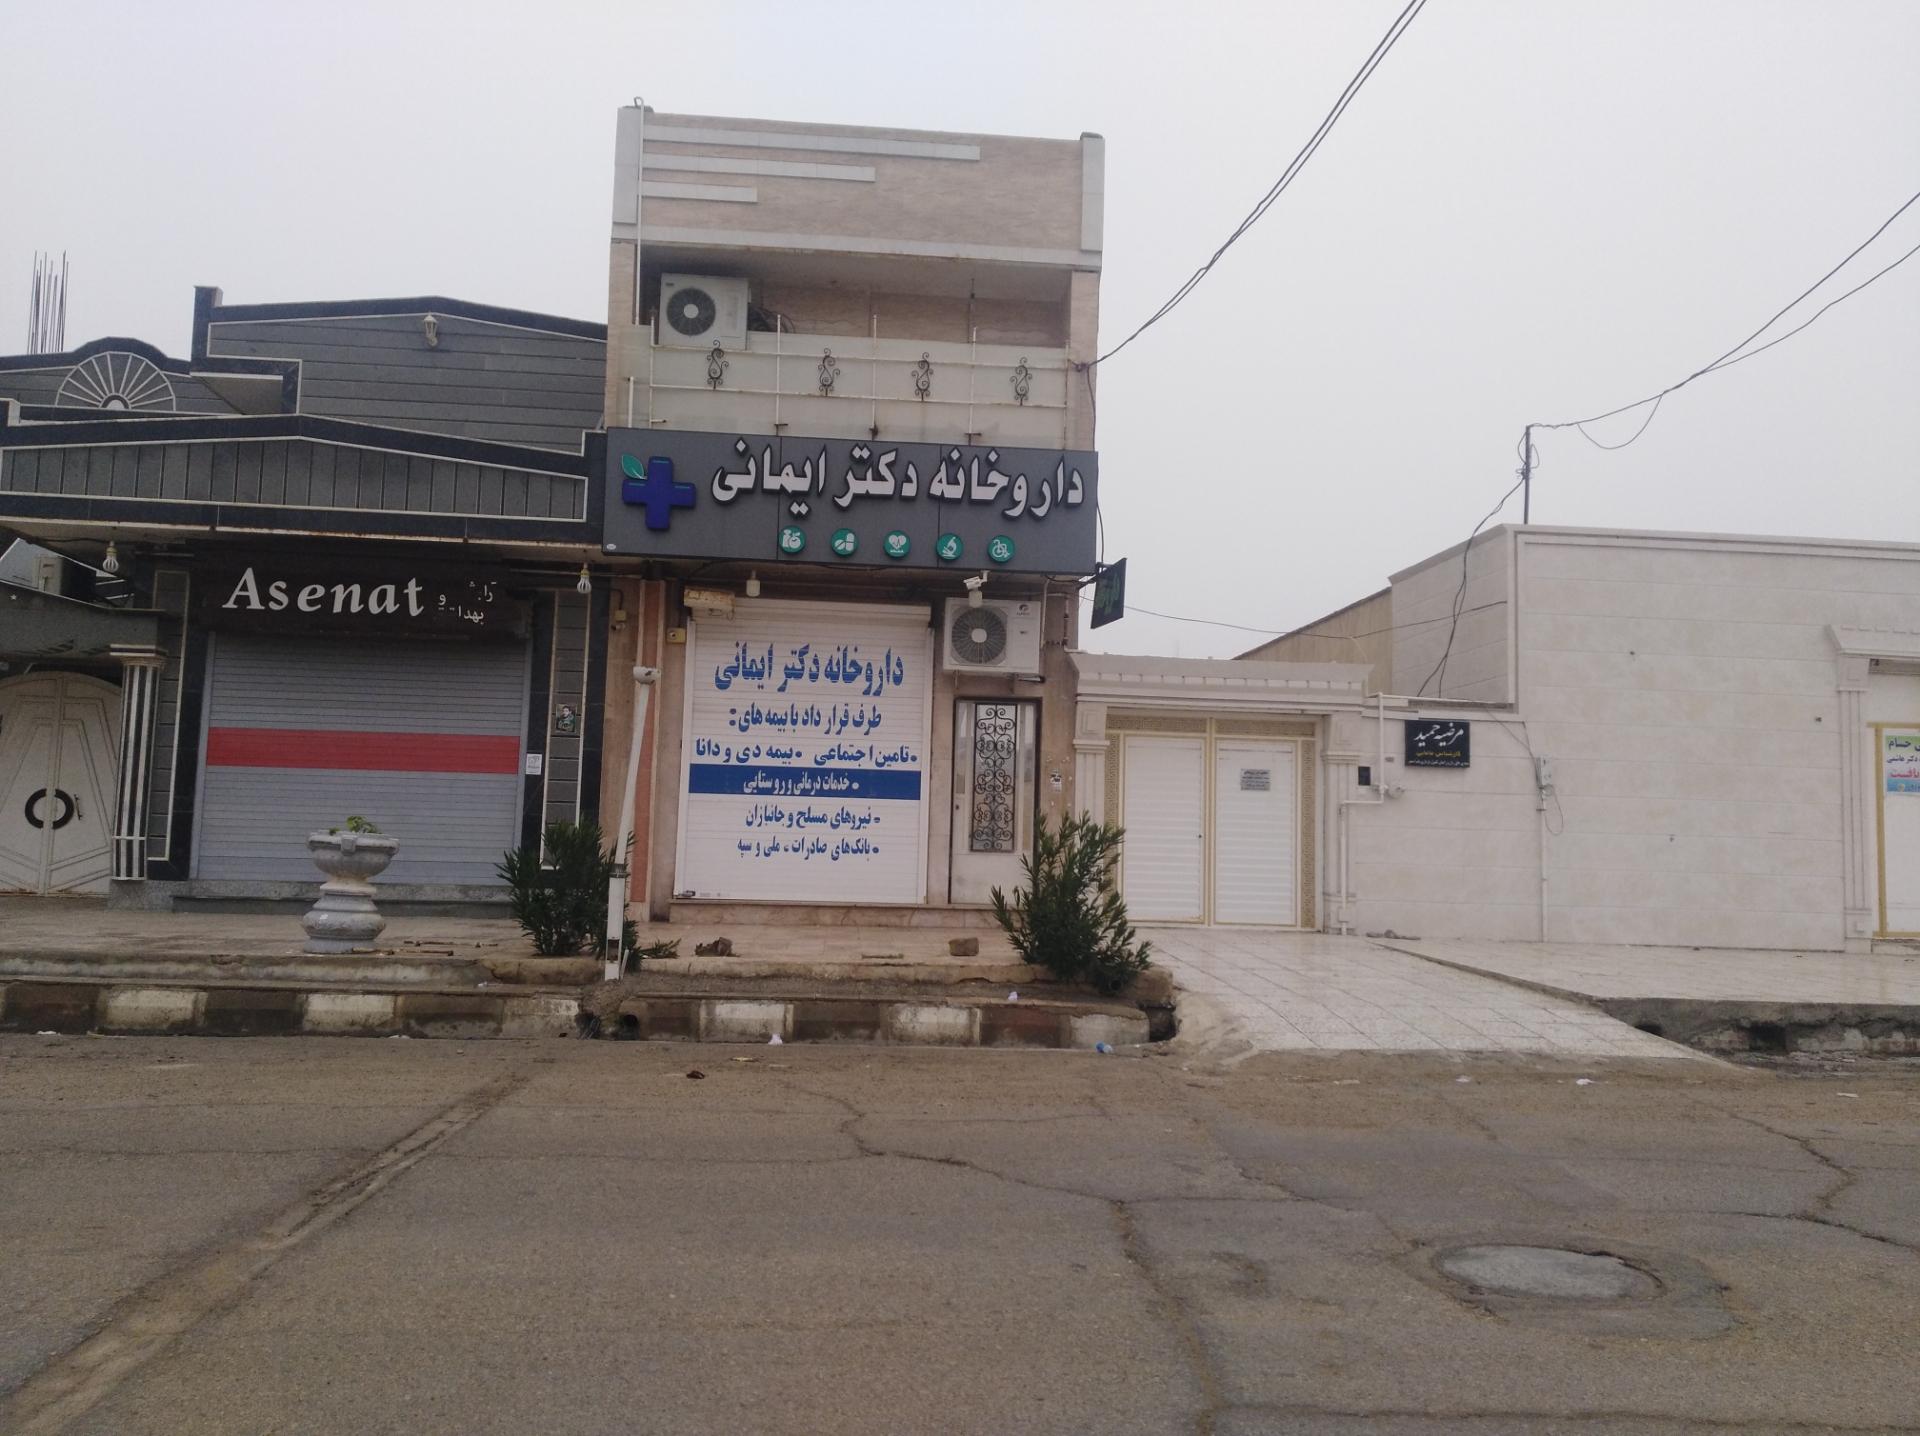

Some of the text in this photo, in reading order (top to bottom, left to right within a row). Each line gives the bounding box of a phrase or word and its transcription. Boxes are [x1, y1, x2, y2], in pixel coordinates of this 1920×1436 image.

[711, 437, 1084, 519] داروخانه دکتر ایمانی
[222, 567, 424, 617] Asenat
[714, 641, 904, 697] داروخانه دکتر ایمانی
[852, 703, 882, 735] طرف
[696, 737, 720, 757] دانا
[722, 748, 731, 763] و
[765, 744, 793, 765] بیمه
[814, 743, 873, 768] اجتماعی
[743, 770, 785, 795] روستایی
[793, 770, 820, 796] درمانی
[822, 771, 850, 791] خدمات
[746, 803, 872, 830] نیروهای مسلح و جانبازان
[755, 841, 760, 857] و
[764, 836, 780, 857] ملی
[792, 836, 827, 860] صادرات
